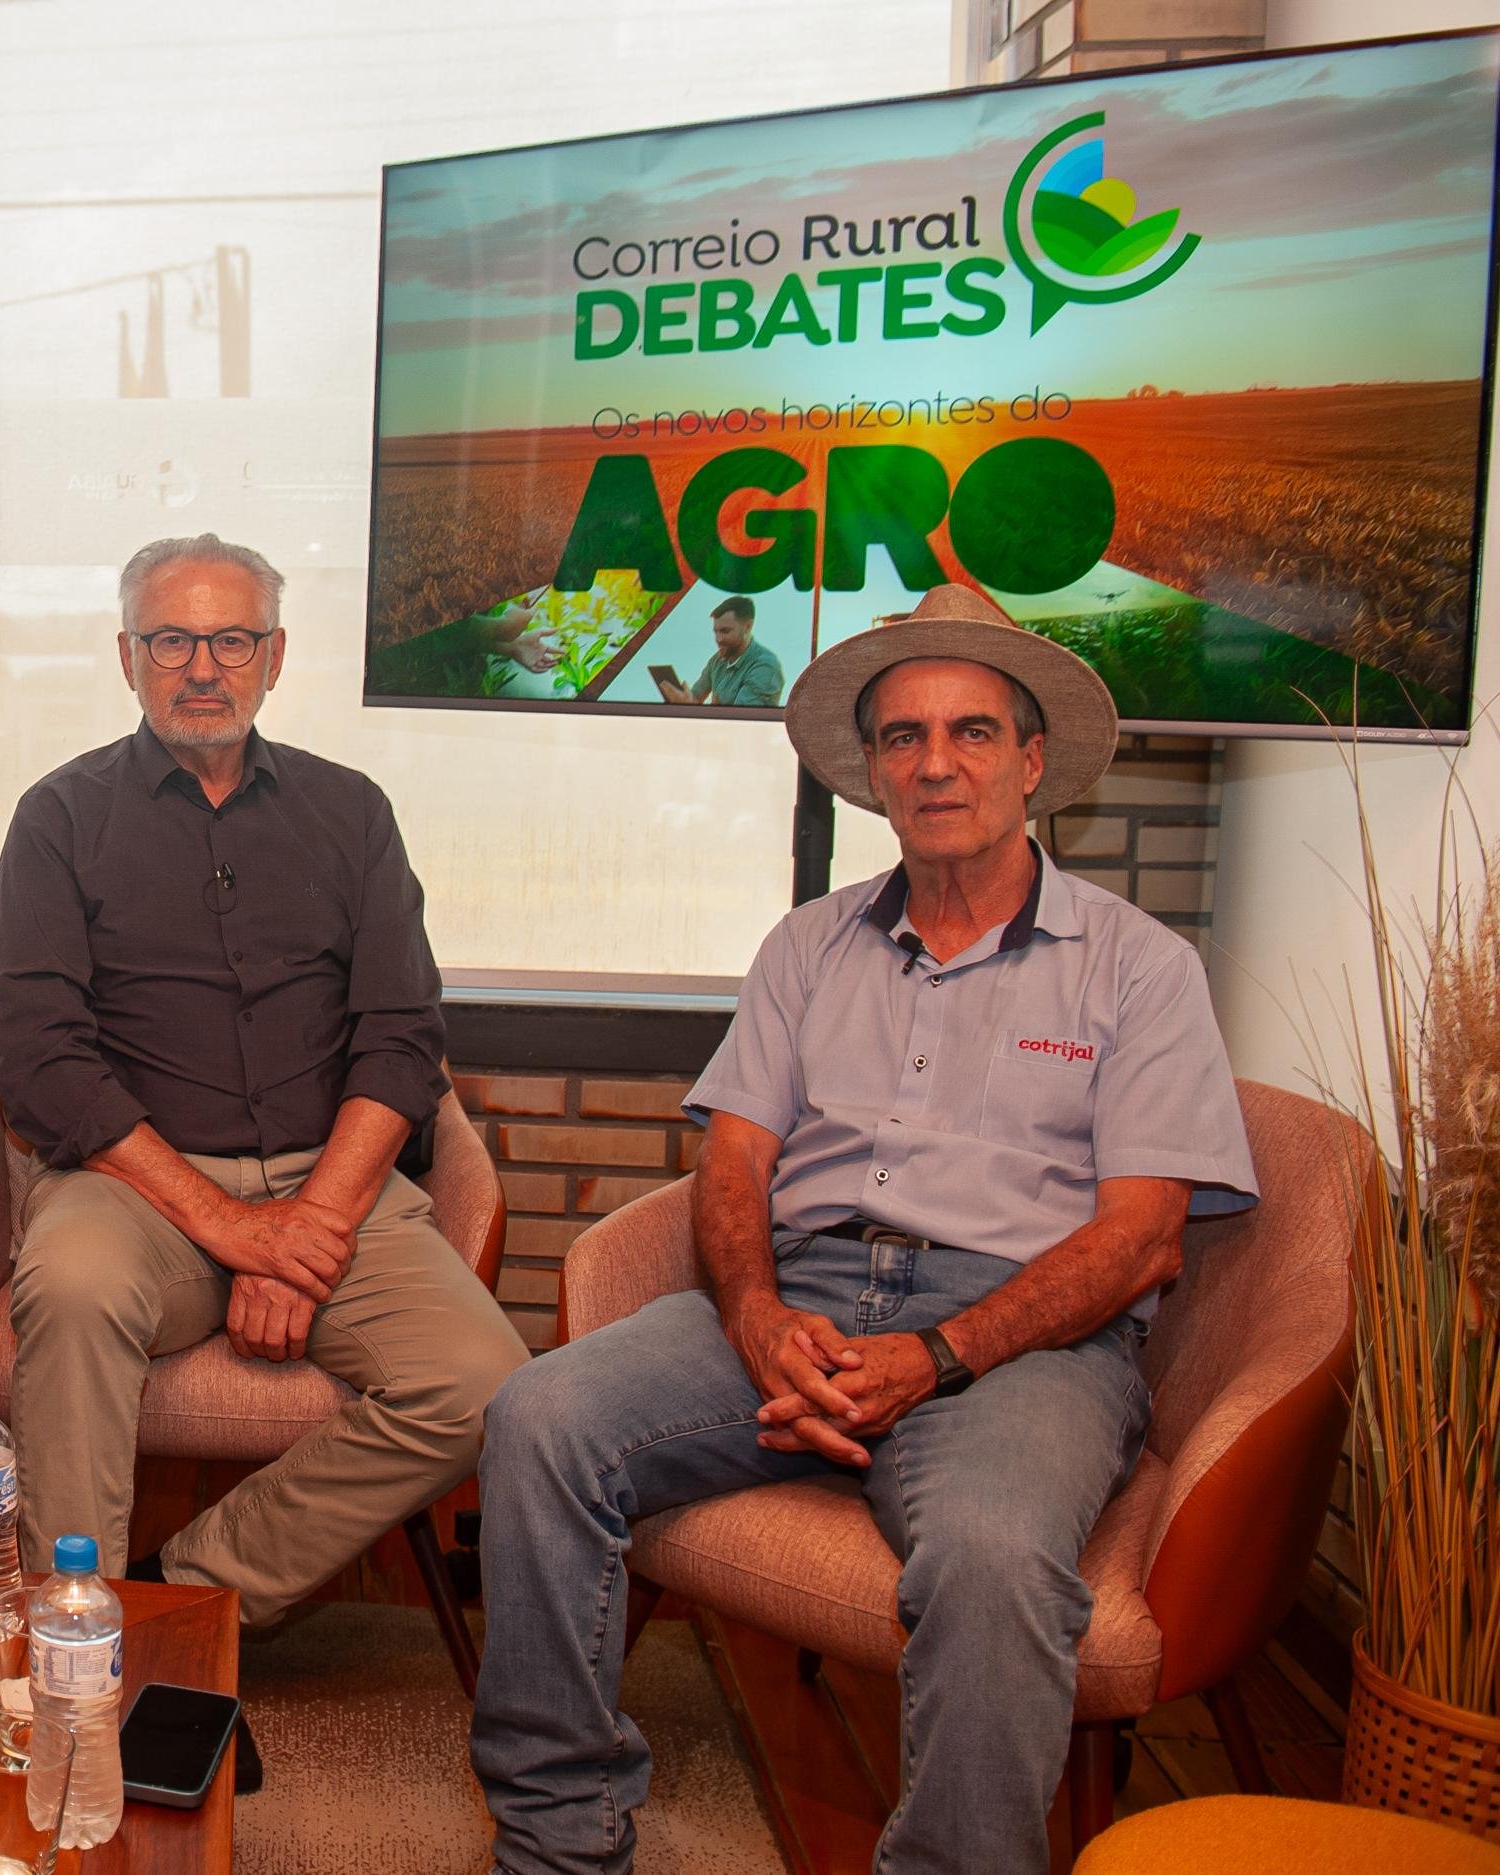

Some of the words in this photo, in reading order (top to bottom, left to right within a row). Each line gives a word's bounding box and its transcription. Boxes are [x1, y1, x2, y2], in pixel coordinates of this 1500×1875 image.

[572, 218, 781, 282] Correio
[803, 195, 981, 262] Rural
[573, 256, 1007, 362] DEBATES
[592, 406, 640, 440] Os
[653, 402, 767, 436] novos
[782, 388, 995, 433] horizontes
[1010, 385, 1073, 423] do
[550, 436, 1117, 595] AGRO
[1018, 1038, 1095, 1062] cotrijal
